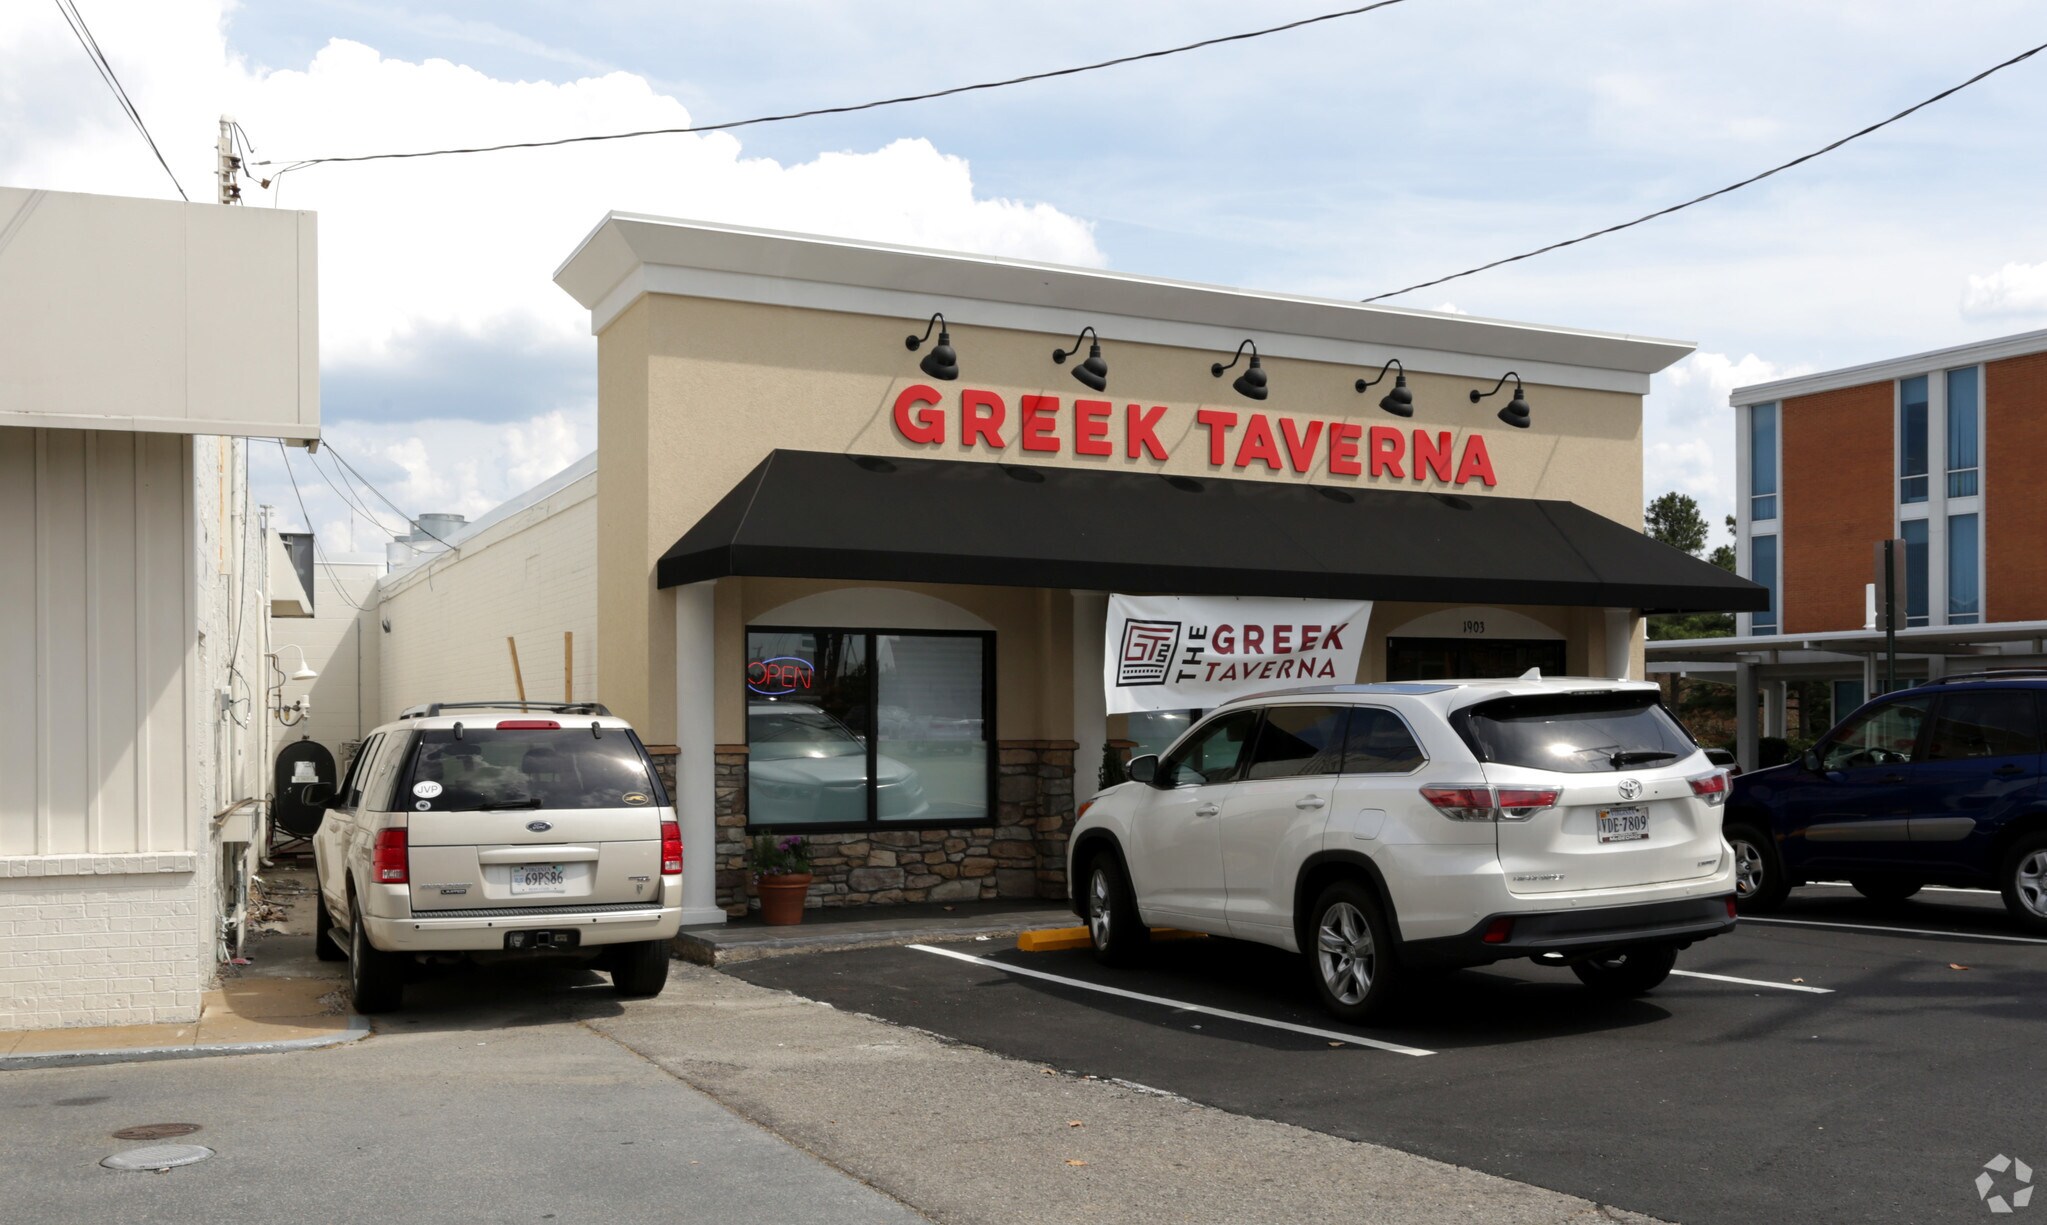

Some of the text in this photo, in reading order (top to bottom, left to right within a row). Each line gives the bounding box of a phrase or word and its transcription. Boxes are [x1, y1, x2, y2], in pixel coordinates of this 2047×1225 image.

[894, 384, 1497, 487] GREEK TAVERNA
[1211, 622, 1349, 656] GREEK
[1463, 620, 1485, 634] 1903
[1175, 625, 1208, 684] THE
[747, 661, 811, 689] OPEN
[1204, 657, 1336, 682] TAVERNA
[417, 785, 438, 794] JVP
[525, 871, 564, 886] 69PS86
